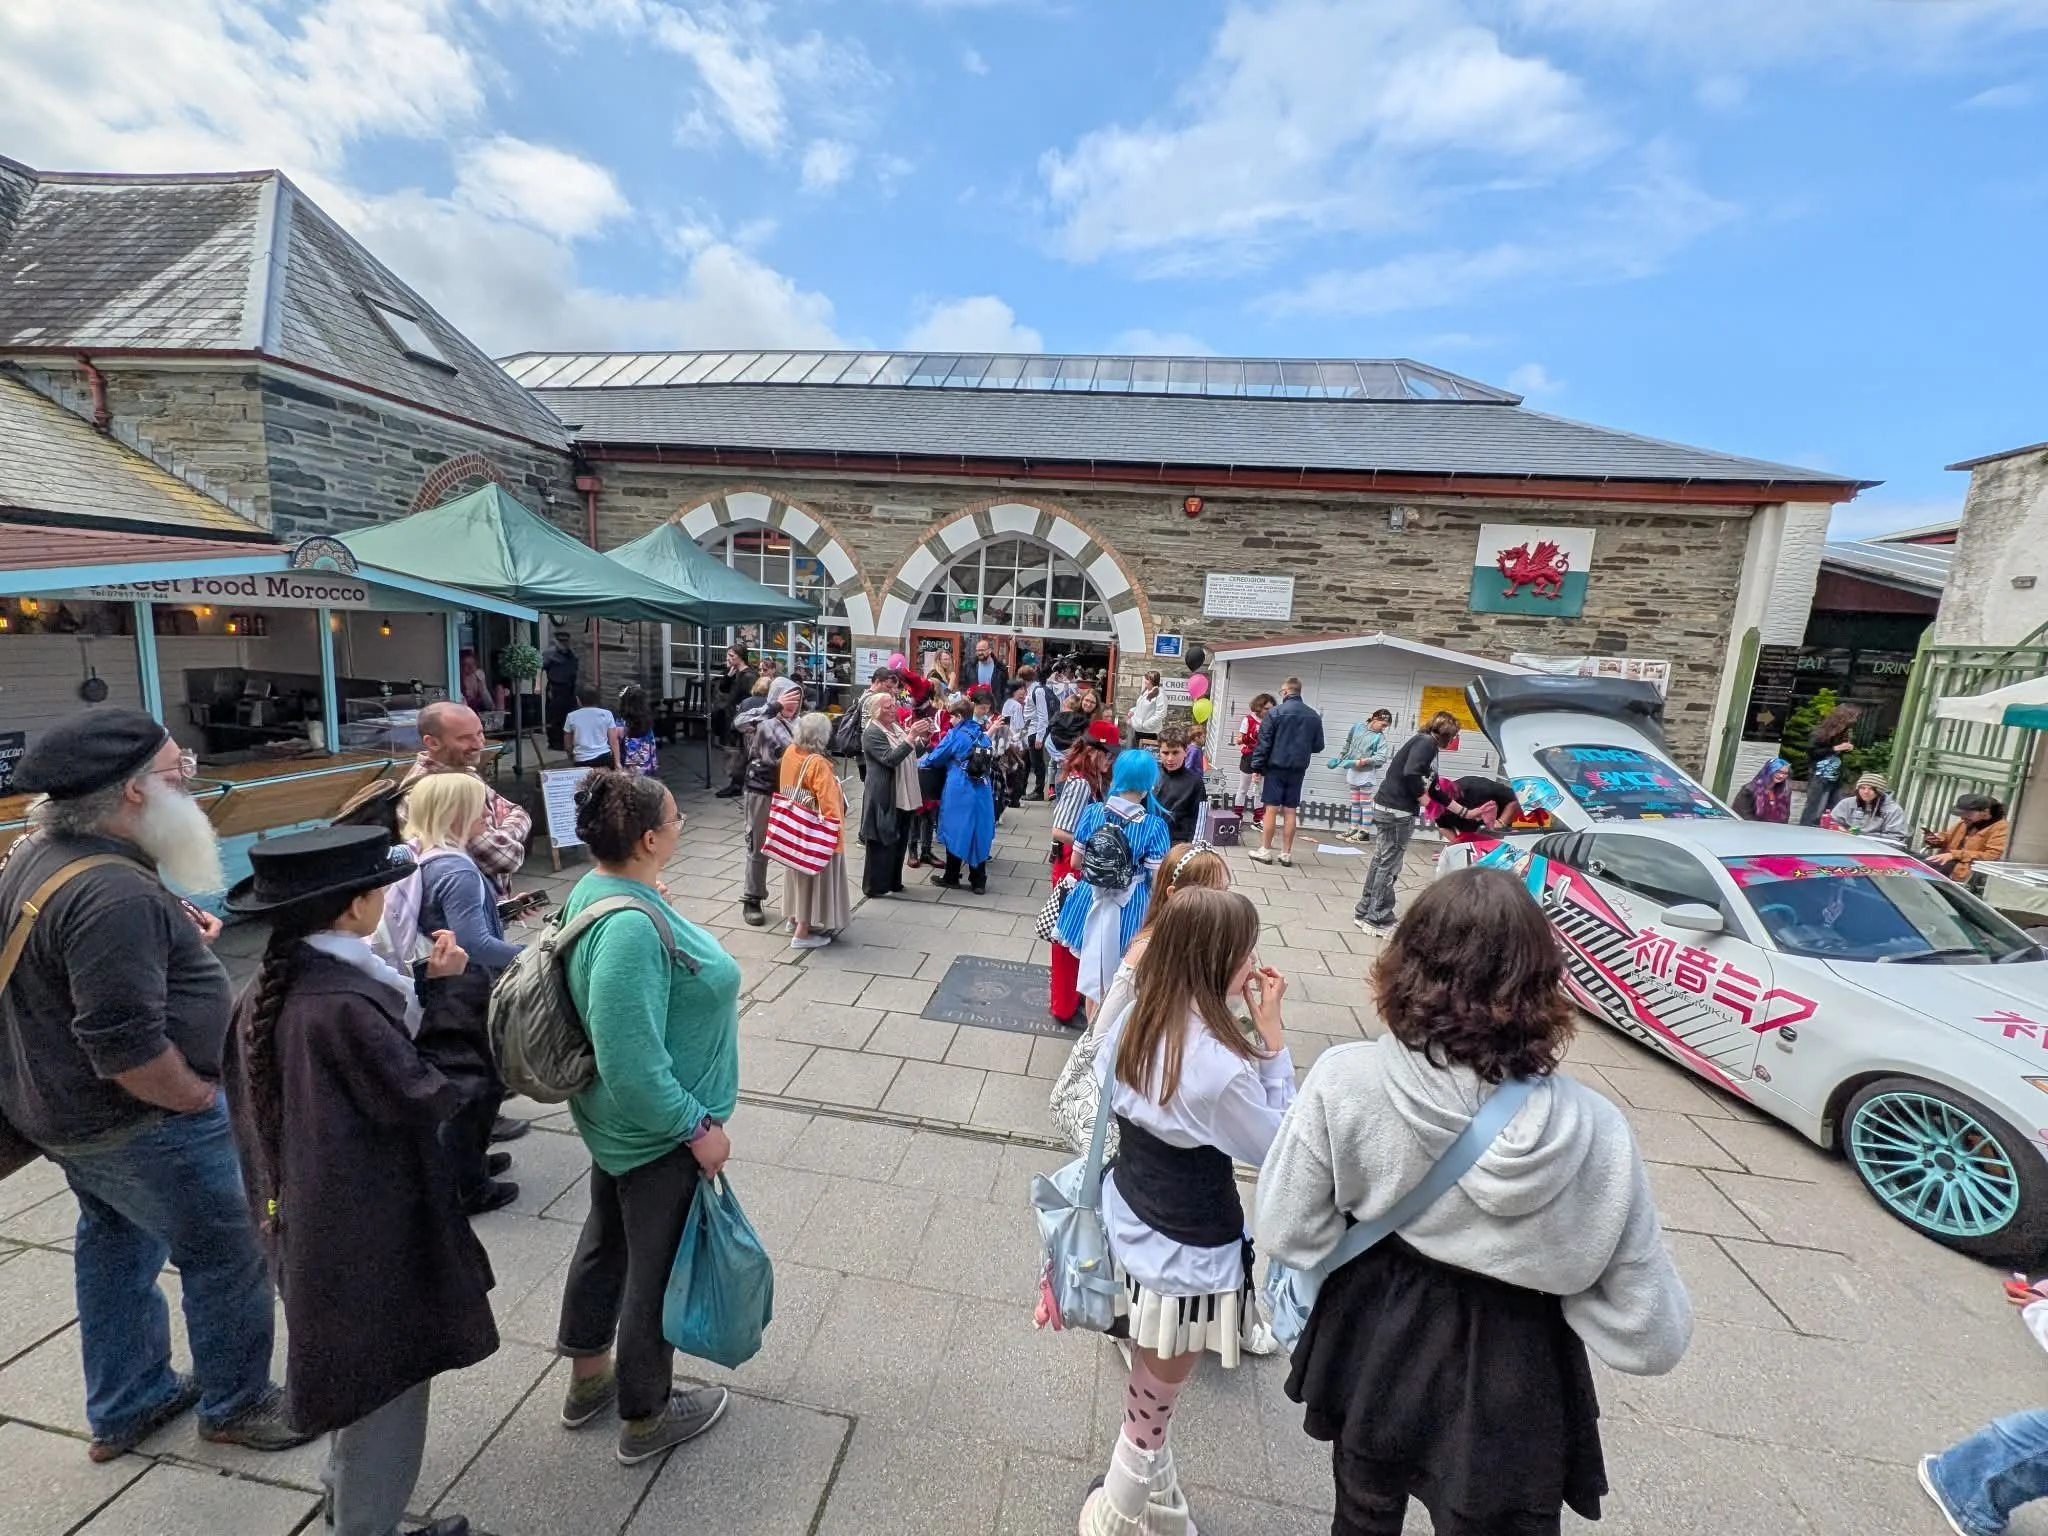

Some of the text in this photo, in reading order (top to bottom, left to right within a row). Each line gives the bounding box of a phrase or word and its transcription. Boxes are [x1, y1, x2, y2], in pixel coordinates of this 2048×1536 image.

[190, 575, 257, 596] Food
[267, 577, 366, 601] Morocco
[1872, 660, 1911, 675] DRIN
[1165, 680, 1188, 689] CROE
[1166, 694, 1192, 702] ELCOM
[1624, 926, 1819, 1034] 初音ミク
[1630, 969, 1733, 1023] HATSUNE MIKU
